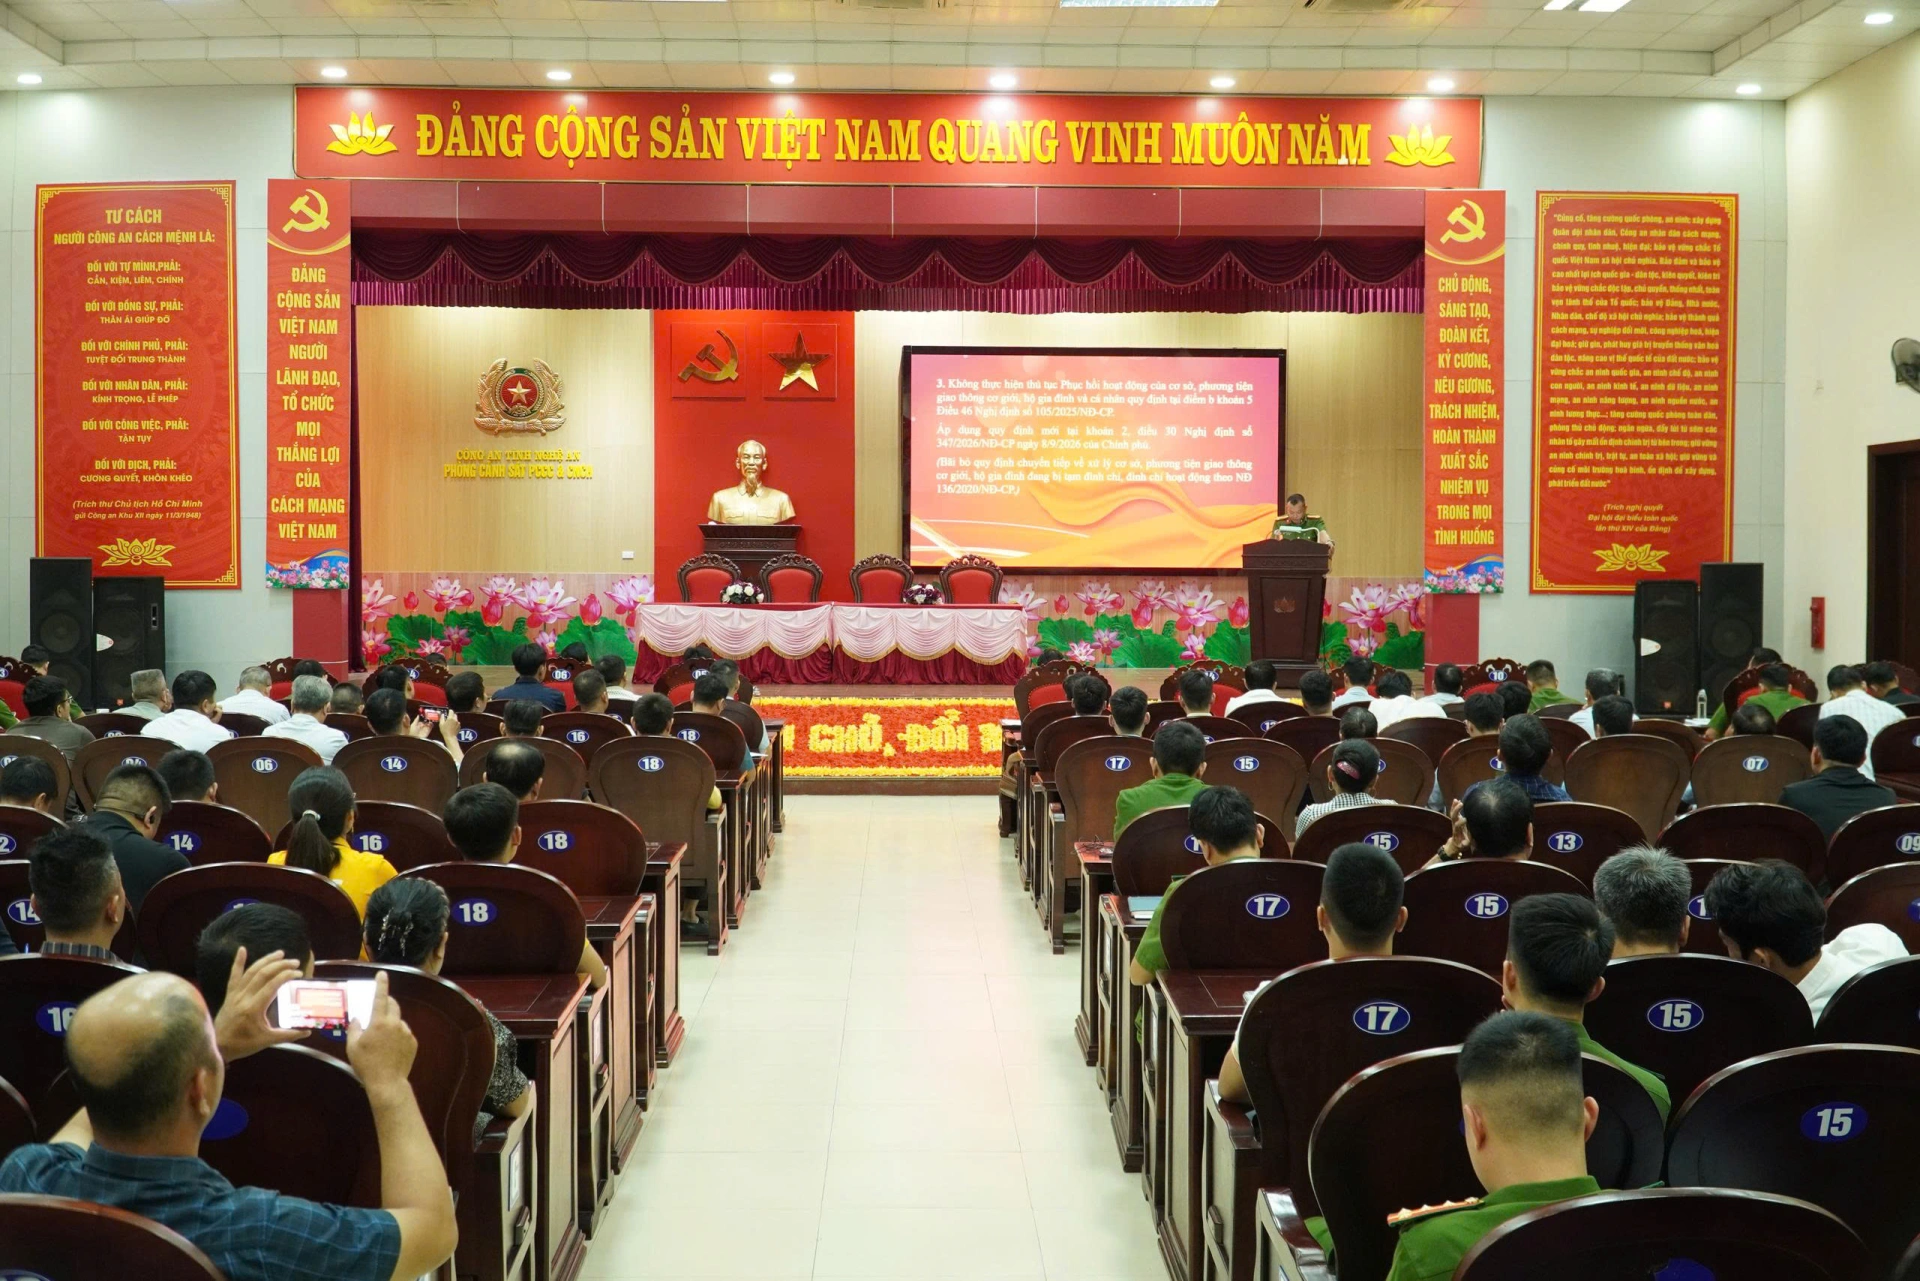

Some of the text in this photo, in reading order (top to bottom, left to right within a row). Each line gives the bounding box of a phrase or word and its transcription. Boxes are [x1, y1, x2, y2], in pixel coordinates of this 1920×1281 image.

[416, 100, 1371, 171] ĐẢNG CỘNG SẢN VIỆT NAM QUANG VINH MUÔN NĂM
[105, 207, 162, 224] TƯ CÁCH
[54, 229, 215, 245] NGƯỜI CÔNG AN CÁCH MỆNH LÀ:
[291, 263, 326, 283] ĐẢNG
[1438, 273, 1492, 295] CHỦ ĐỘNG,
[277, 289, 340, 311] CỘNG SẢN
[1439, 300, 1490, 321] SÁNG TẠO,
[279, 316, 337, 337] VIỆT NAM
[1440, 324, 1490, 344] ĐOÀN KẾT,
[289, 341, 327, 360] NGƯỜI
[1438, 349, 1491, 369] KỶ CƯƠNG,
[276, 368, 340, 388] LÃNH ĐẠO,
[1435, 376, 1494, 395] NÊU GƯƠNG,
[283, 390, 334, 411] TỔ CHỨC
[1429, 401, 1500, 422] TRÁCH NHIỆM,
[296, 422, 320, 439] MỌI
[1433, 426, 1496, 444] HOÀN THÀNH
[277, 442, 340, 465] THẮNG LỢI
[1441, 449, 1488, 469] XUẤT SẮC
[296, 468, 320, 488] CỦA
[1440, 477, 1488, 497] NHIỆM VỤ
[271, 495, 345, 516] CÁCH MẠNG
[1437, 505, 1492, 522] TRONG MỌI
[279, 520, 336, 541] VIỆT NAM
[1435, 525, 1494, 544] TÌNH HUỐNG
[555, 670, 566, 678] 06
[1493, 671, 1504, 680] 10
[459, 731, 473, 740] 14
[572, 732, 585, 741] 16
[682, 731, 696, 740] 18
[256, 760, 273, 770] 06
[386, 759, 402, 769] 14
[643, 759, 659, 769] 18
[1110, 758, 1125, 768] 17
[1240, 759, 1253, 769] 15
[1747, 759, 1764, 769] 07
[171, 835, 193, 850] 14
[360, 835, 382, 851] 16
[544, 834, 568, 850] 18
[1372, 835, 1391, 850] 15
[1556, 835, 1575, 850] 13
[460, 903, 488, 922] 18
[1254, 897, 1280, 916] 17
[1475, 896, 1499, 914] 15
[1364, 1007, 1398, 1030] 17
[1660, 1004, 1691, 1027] 15
[1817, 1108, 1853, 1136] 15
